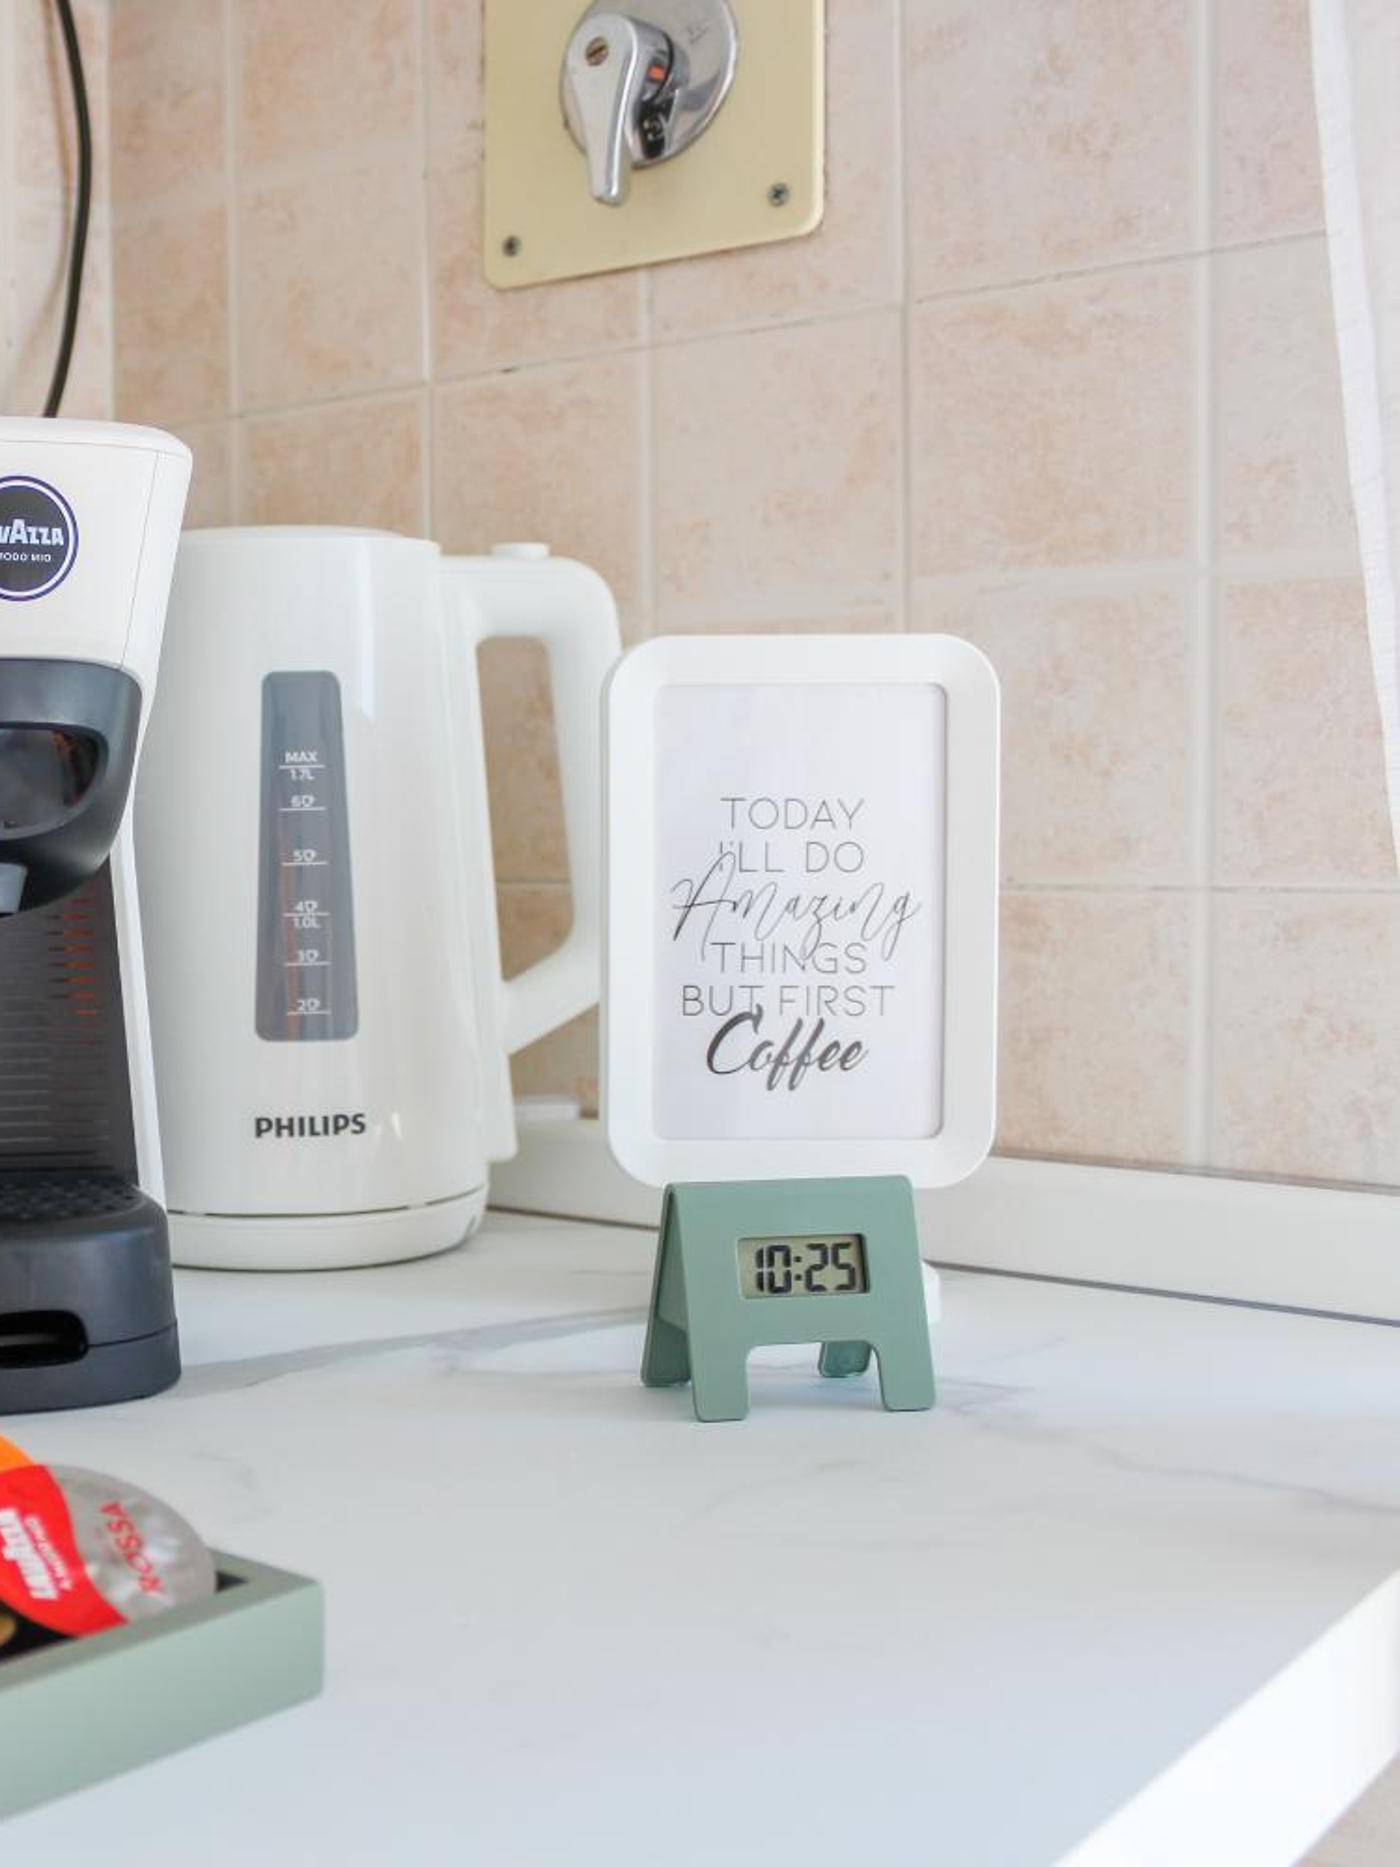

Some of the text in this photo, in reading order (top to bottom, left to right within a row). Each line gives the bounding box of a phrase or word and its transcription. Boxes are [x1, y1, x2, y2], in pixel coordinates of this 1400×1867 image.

[31, 552, 52, 563] MIO
[285, 751, 318, 764] MAX
[719, 797, 865, 829] TODAY
[805, 841, 865, 873] DO
[669, 850, 922, 962] Amazing
[709, 942, 868, 974] THINGS
[681, 985, 896, 1017] BUT FIRST
[706, 1003, 869, 1091] Coffee
[255, 1113, 366, 1139] PHILIPS
[755, 1242, 856, 1294] 10:25
